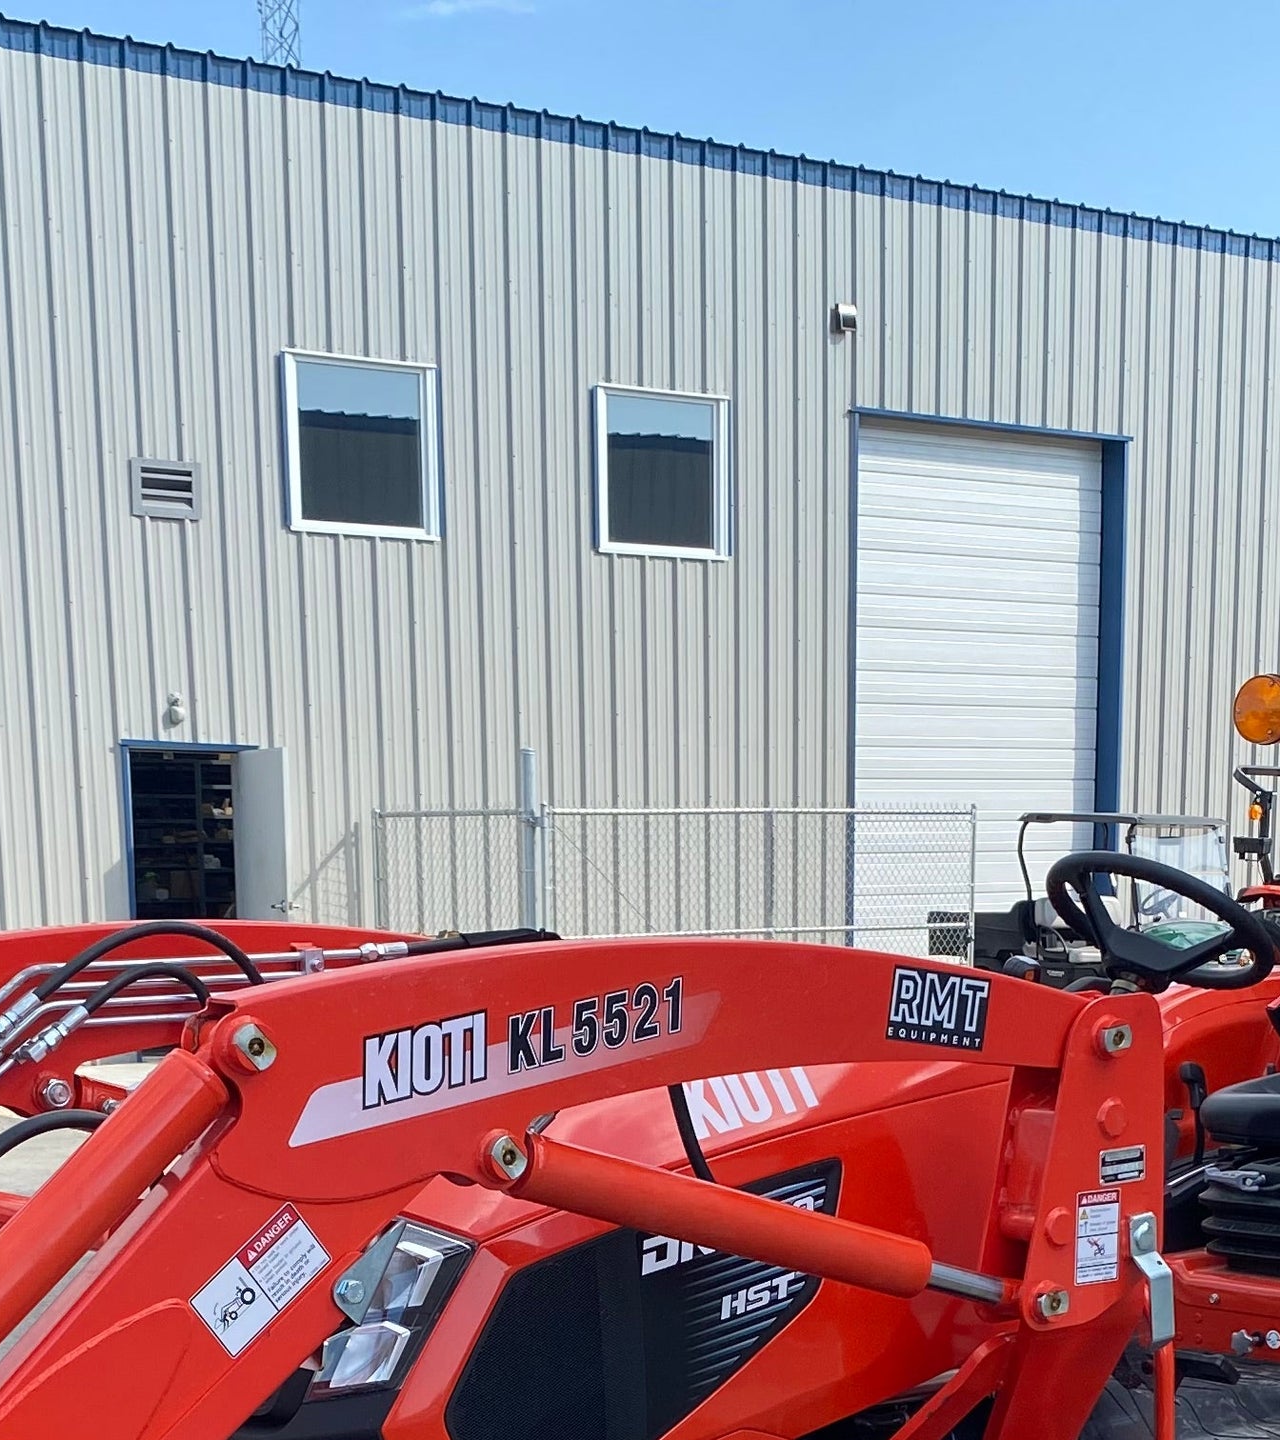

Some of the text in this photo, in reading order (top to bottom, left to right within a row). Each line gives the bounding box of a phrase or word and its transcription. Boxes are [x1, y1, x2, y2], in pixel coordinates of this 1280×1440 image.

[890, 968, 989, 1032] RMT
[362, 975, 684, 1110] KIOTI KL 5521
[887, 1026, 981, 1048] EQUIPMENT
[1087, 1192, 1118, 1204] DANGER
[253, 1212, 293, 1252] DANGER
[720, 1271, 796, 1321] HST
